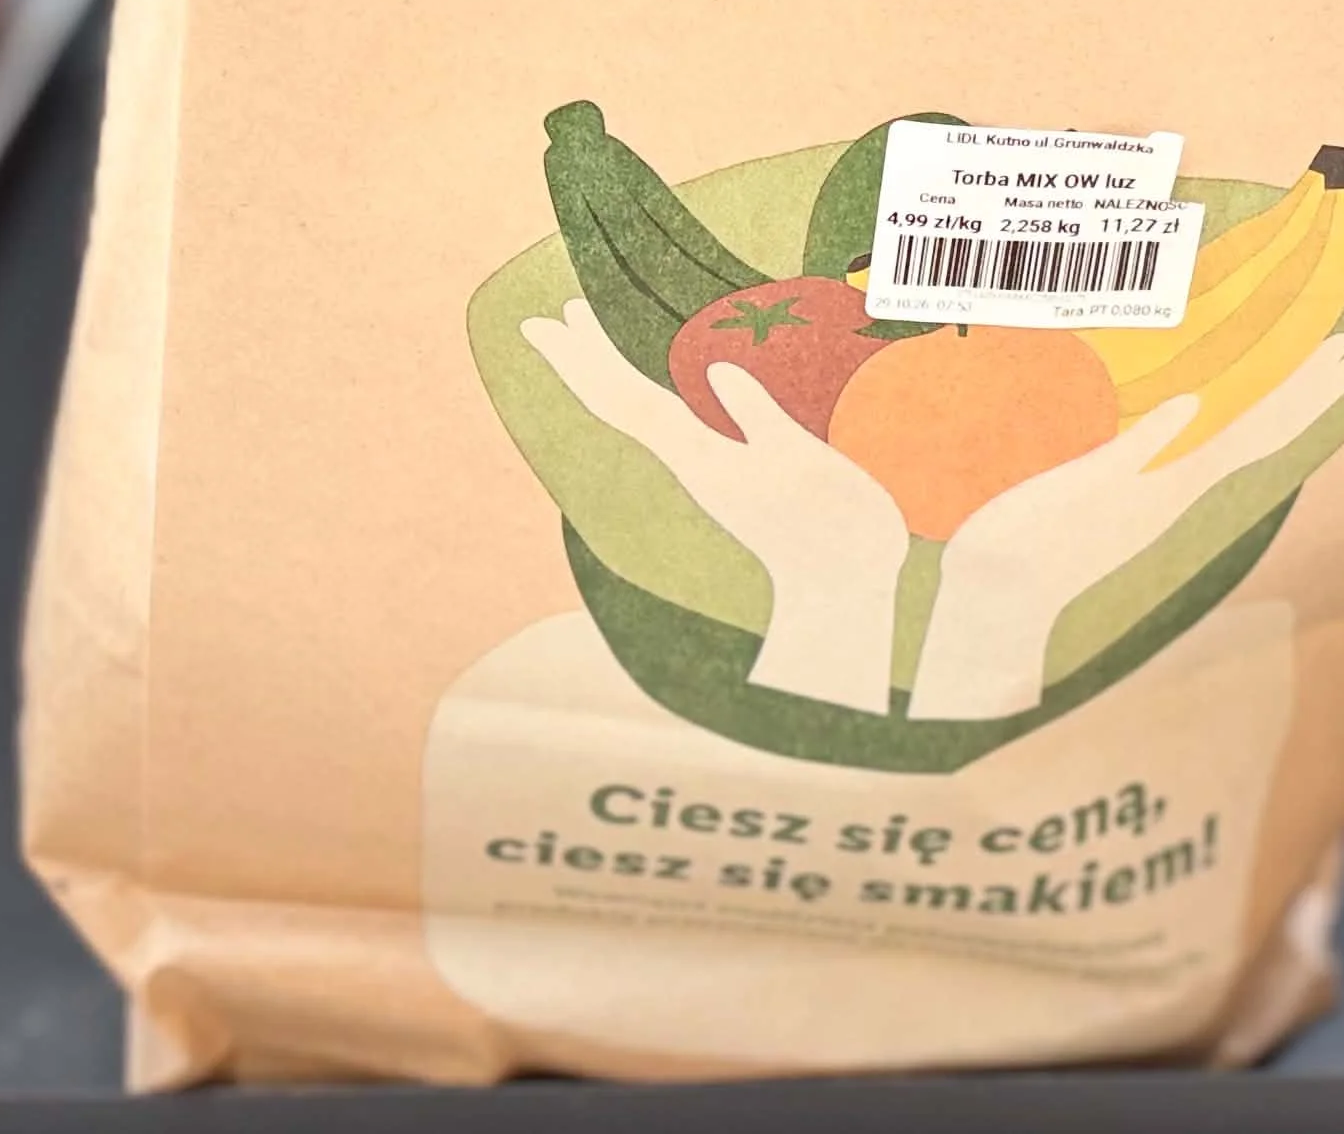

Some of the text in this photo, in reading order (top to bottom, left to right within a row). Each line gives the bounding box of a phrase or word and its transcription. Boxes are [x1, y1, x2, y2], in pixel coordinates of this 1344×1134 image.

[946, 132, 981, 145] LIDL
[986, 134, 1031, 148] Kutno
[1054, 137, 1155, 155] Grunwaldzka
[952, 169, 1136, 189] Torba MIX OW luz
[919, 192, 956, 205] Cena
[1004, 197, 1043, 208] Masa
[1047, 198, 1083, 209] netto
[887, 212, 1180, 237] 4,99 zł/kg 2,258 kg 11,27 zł
[1055, 306, 1084, 318] Tara
[589, 781, 1167, 866] Ciesz się ceną,
[484, 830, 692, 880] ciesz
[717, 857, 832, 903] się
[860, 813, 1219, 914] smakiem!
